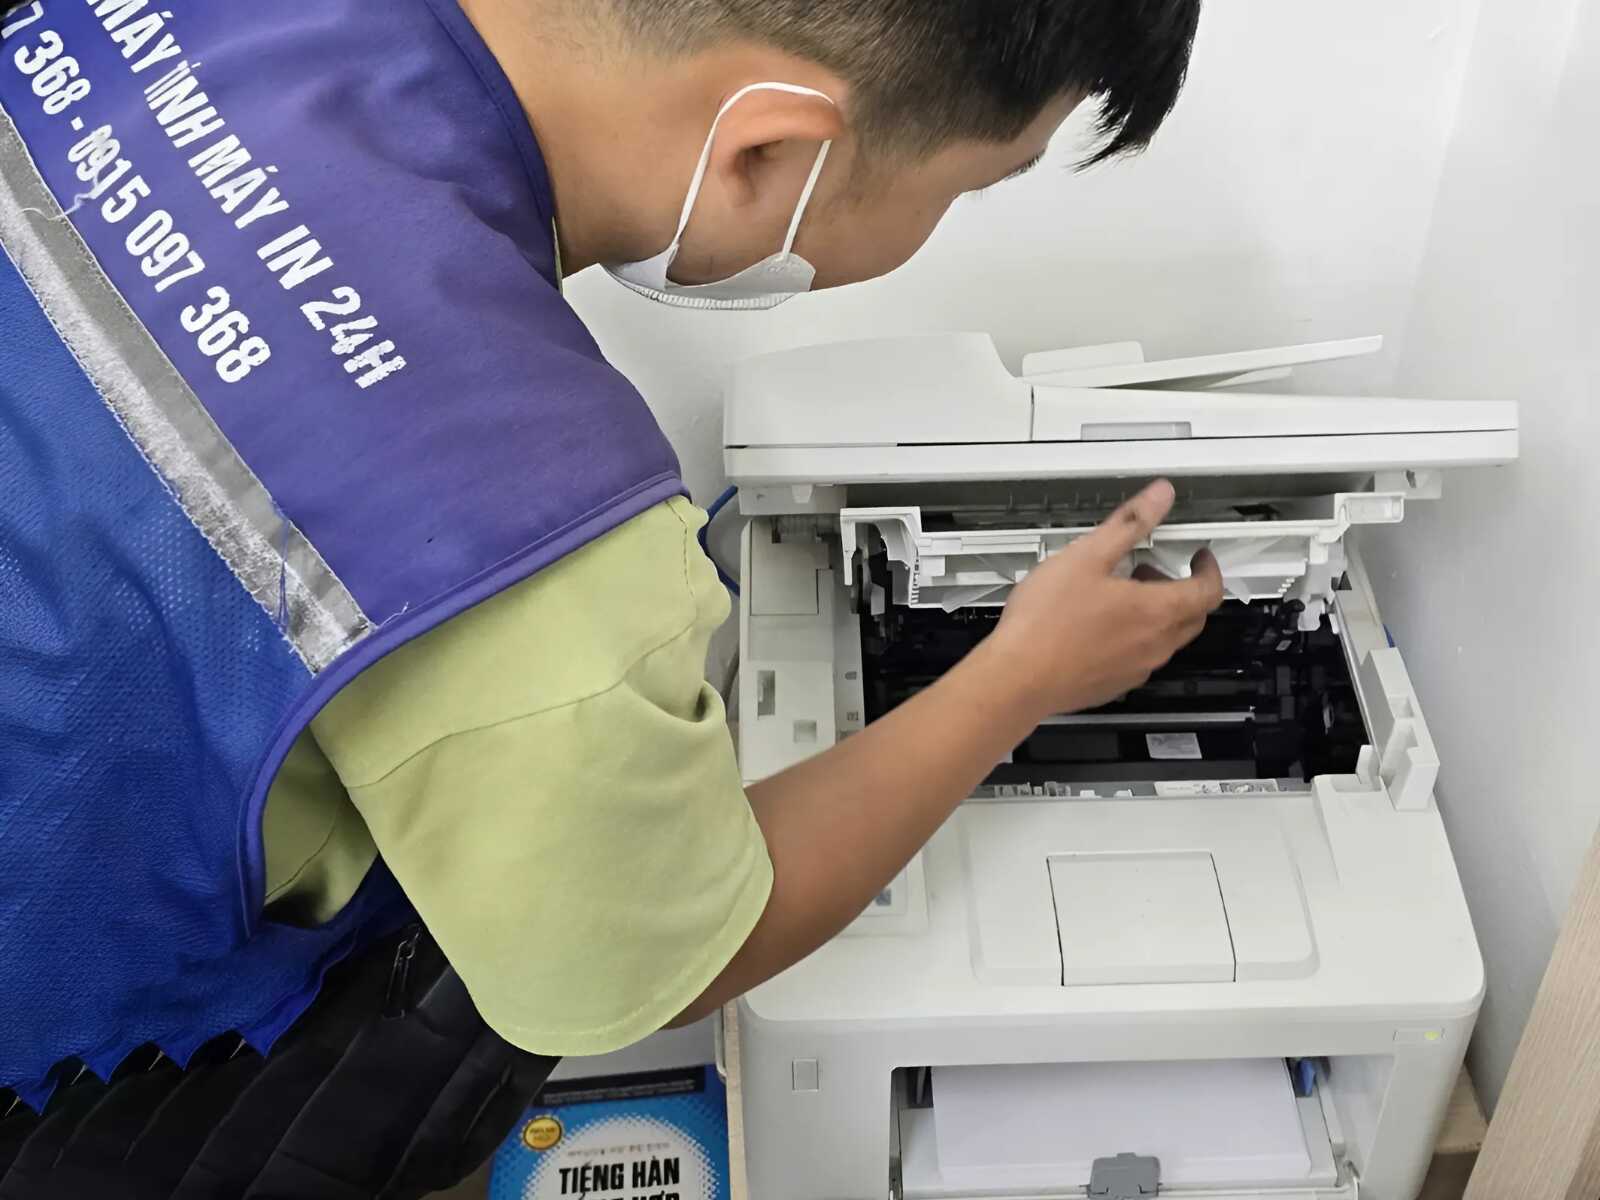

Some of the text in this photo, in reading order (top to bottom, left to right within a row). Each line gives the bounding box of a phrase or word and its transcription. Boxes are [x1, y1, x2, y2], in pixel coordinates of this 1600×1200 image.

[13, 29, 92, 115] 368
[70, 116, 85, 131] -
[67, 124, 152, 224] 0915
[85, 0, 182, 75] MÁY
[187, 133, 290, 230] MÁY
[256, 224, 335, 290] IN
[299, 285, 407, 389] 24H
[124, 209, 206, 293] 097
[179, 285, 272, 384] 368
[631, 1155, 680, 1189] HÀN
